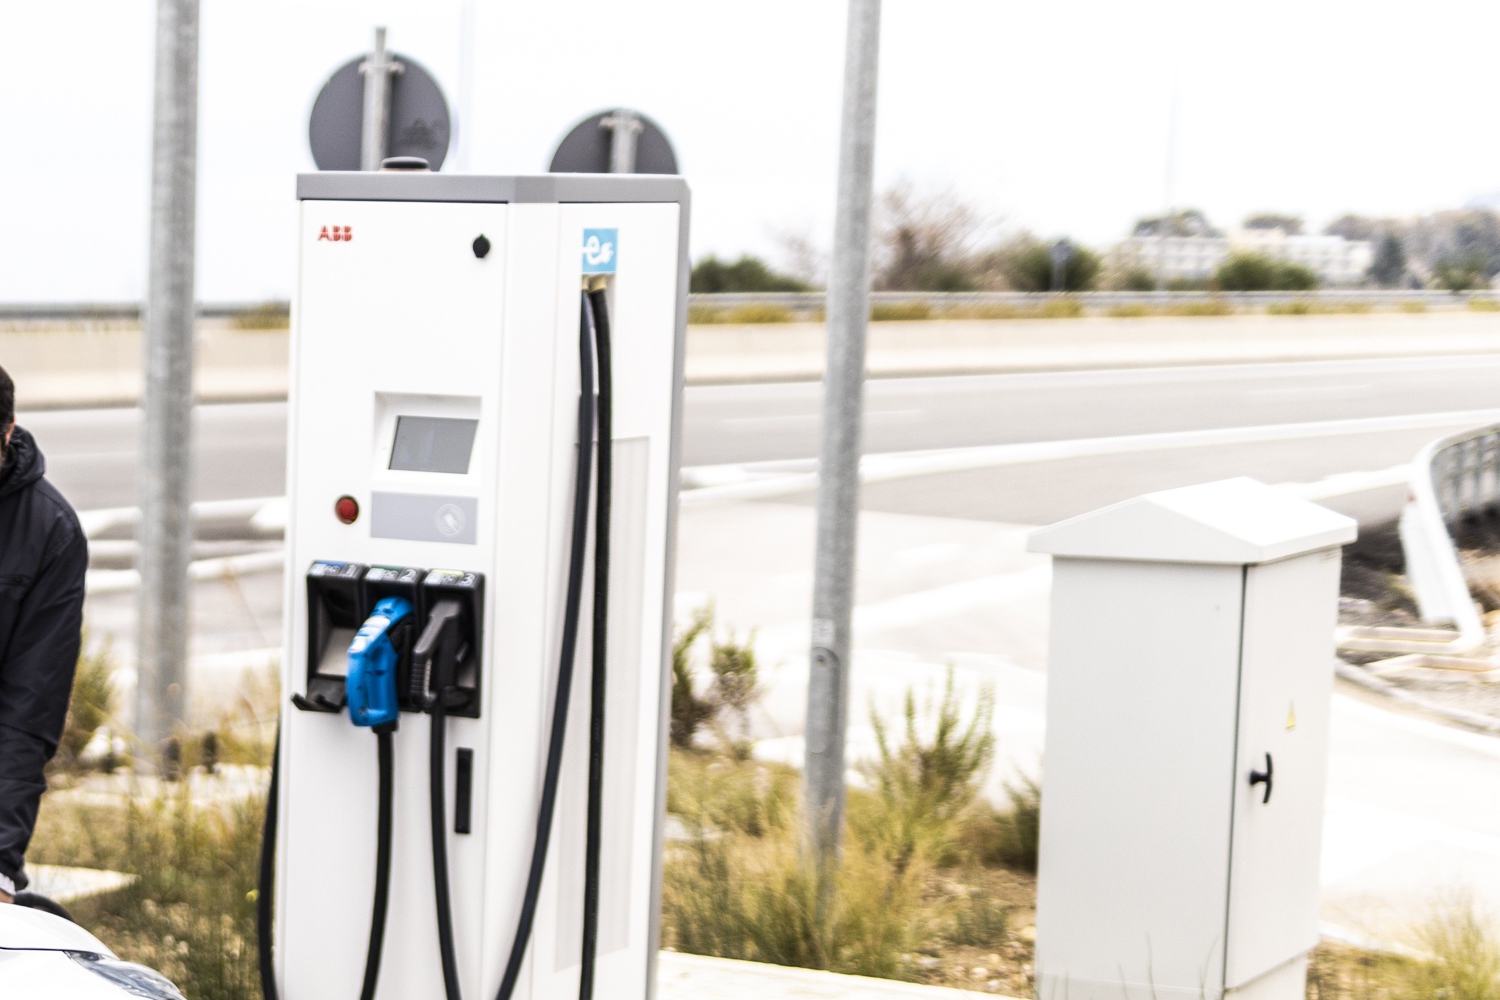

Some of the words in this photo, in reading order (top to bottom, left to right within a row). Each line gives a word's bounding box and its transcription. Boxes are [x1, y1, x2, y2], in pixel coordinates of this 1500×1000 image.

[318, 225, 352, 241] ABB
[400, 568, 417, 582] 2
[458, 572, 476, 587] 3
